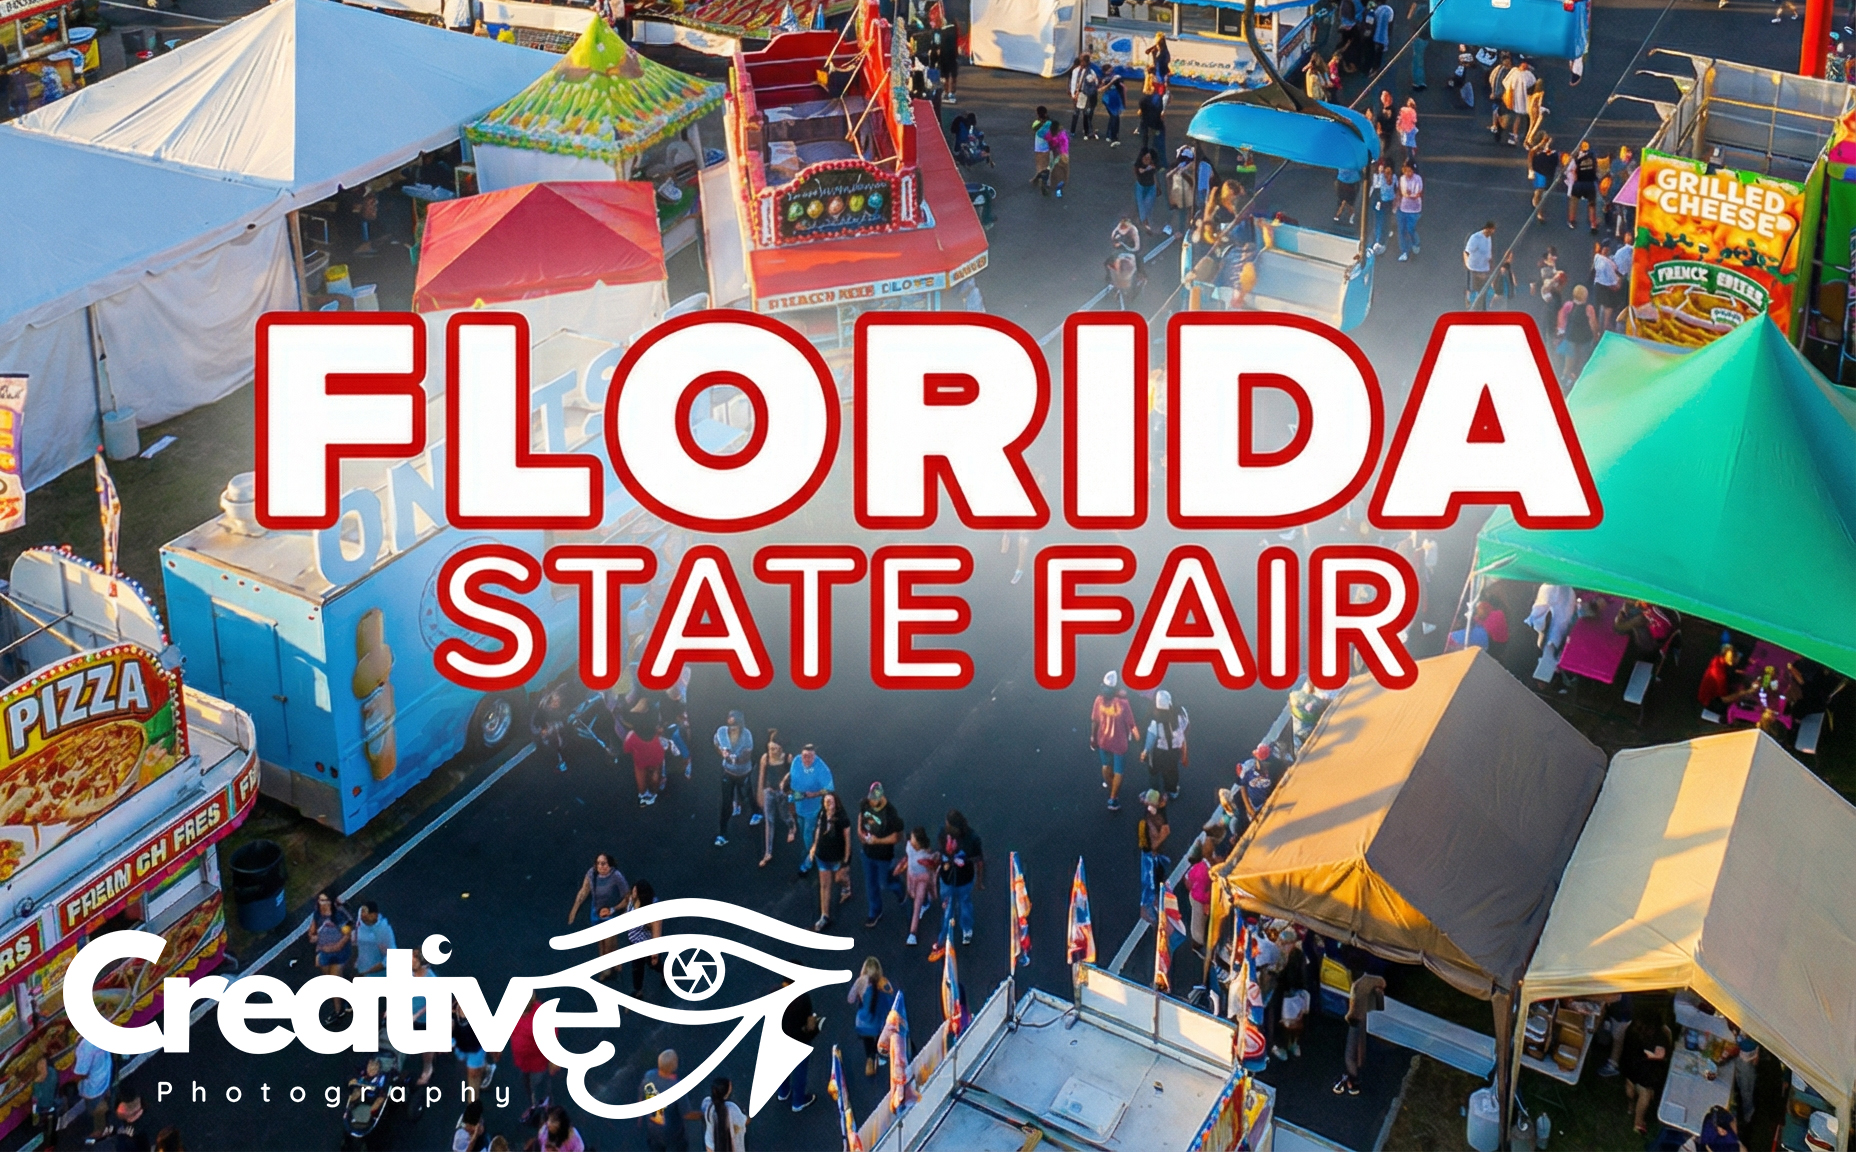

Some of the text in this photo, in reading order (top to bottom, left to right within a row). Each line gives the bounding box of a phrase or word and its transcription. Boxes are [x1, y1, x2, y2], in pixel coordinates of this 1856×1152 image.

[1657, 168, 1785, 214] GRILLED
[1660, 191, 1777, 239] CHEESE
[8, 660, 149, 750] PIZZA
